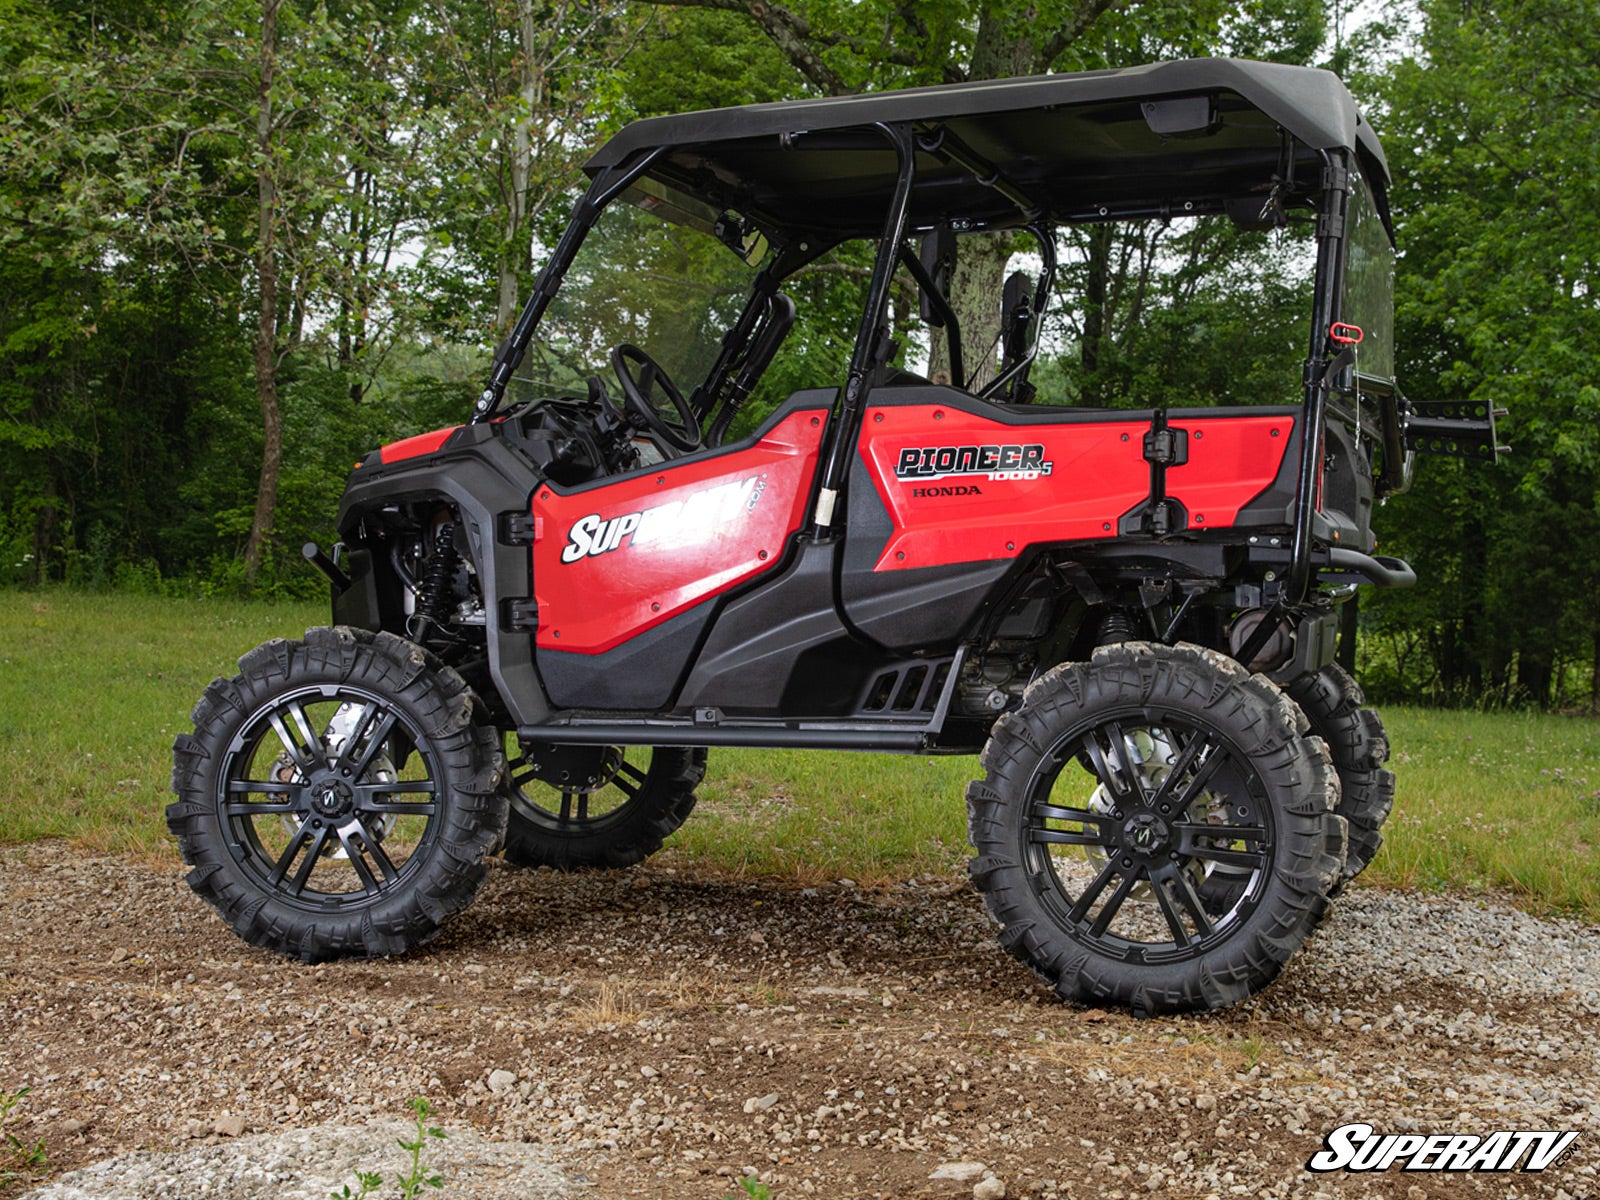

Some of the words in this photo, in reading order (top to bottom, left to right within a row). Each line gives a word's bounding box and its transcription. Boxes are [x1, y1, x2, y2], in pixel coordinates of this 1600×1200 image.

[897, 444, 1045, 475] PIONEER
[987, 471, 1040, 481] 1000
[1041, 461, 1053, 476] 5
[913, 485, 982, 498] HONDA
